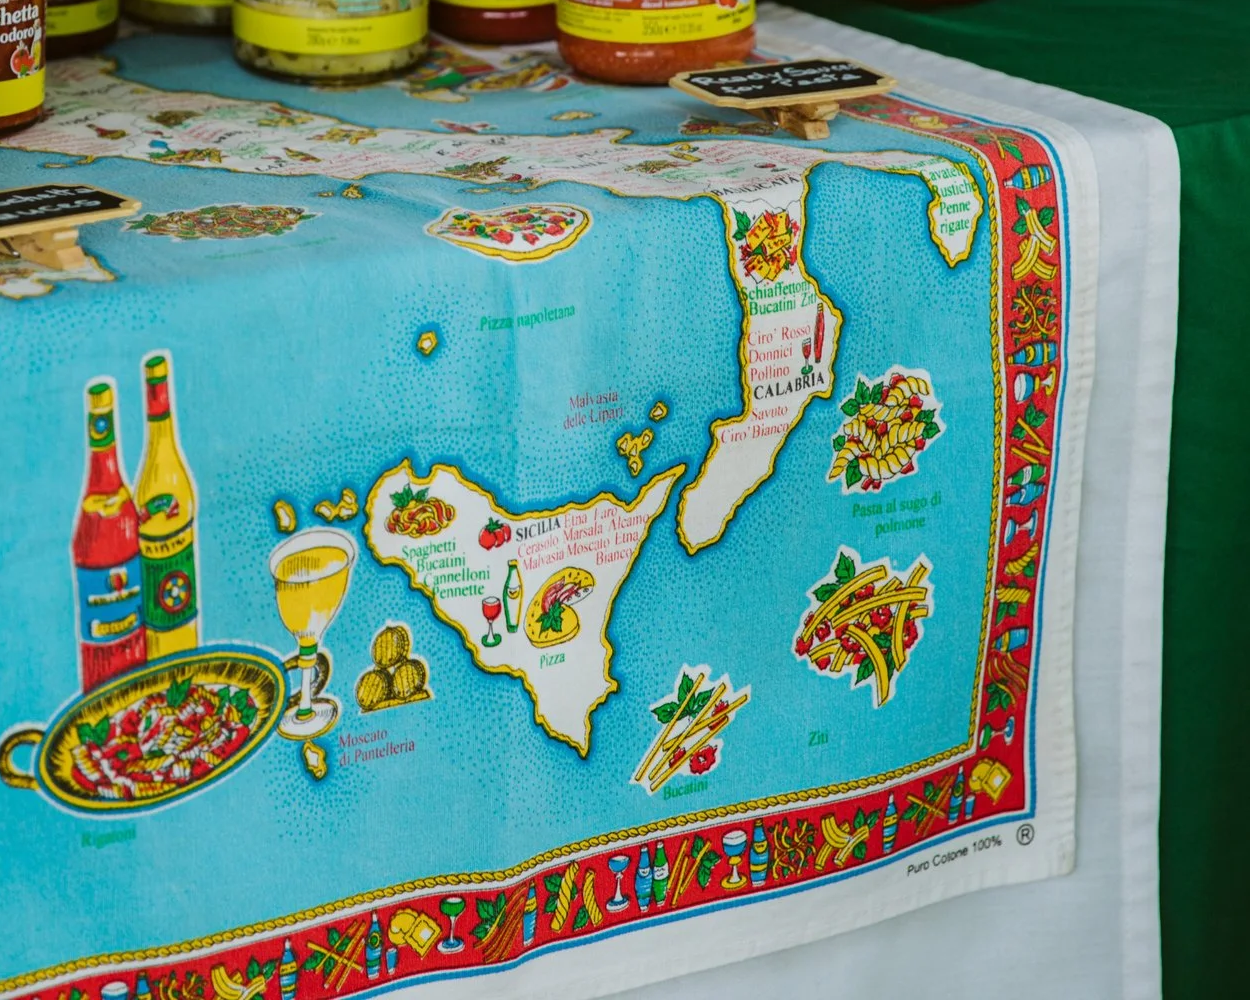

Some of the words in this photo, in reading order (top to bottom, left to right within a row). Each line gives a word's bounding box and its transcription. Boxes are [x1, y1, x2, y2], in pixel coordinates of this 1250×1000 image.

[711, 175, 799, 198] BASILICATA
[932, 180, 977, 199] Rustiche
[939, 202, 971, 216] Penne
[940, 219, 970, 235] rigate
[480, 313, 514, 332] Pizza
[516, 305, 576, 328] napoletana
[750, 300, 797, 317] Bucatini
[781, 325, 811, 340] Rosso
[749, 348, 793, 365] Donnici
[750, 365, 790, 382] Pollino
[753, 372, 825, 400] CALABRIA
[569, 390, 619, 410] Malvasia
[563, 412, 587, 430] delle
[589, 406, 624, 427] Lipari
[751, 405, 788, 421] Savuto
[752, 422, 790, 439] Bianco
[852, 503, 882, 518] Pasta
[886, 498, 897, 514] al
[900, 497, 927, 513] sugo
[931, 491, 941, 506] di
[515, 518, 561, 542] SICILIA
[564, 513, 588, 529] Etna
[563, 523, 603, 542] Marsala
[611, 512, 650, 533] Alcamo
[402, 538, 456, 561] Spaghetti
[523, 551, 565, 571] Malvasia
[567, 537, 610, 558] Moscato
[595, 547, 634, 566] Bianco
[416, 554, 466, 574] Bucatini
[423, 566, 490, 588] Cannelloni
[432, 583, 485, 600] Pennette
[539, 651, 565, 668] Pizza
[338, 730, 388, 749] Moscato
[339, 750, 351, 767] di
[353, 738, 415, 763] Pantelleria
[663, 779, 708, 800] Bucatini
[907, 861, 929, 877] Puro
[932, 848, 968, 872] Cotone
[972, 835, 1002, 852] 100%
